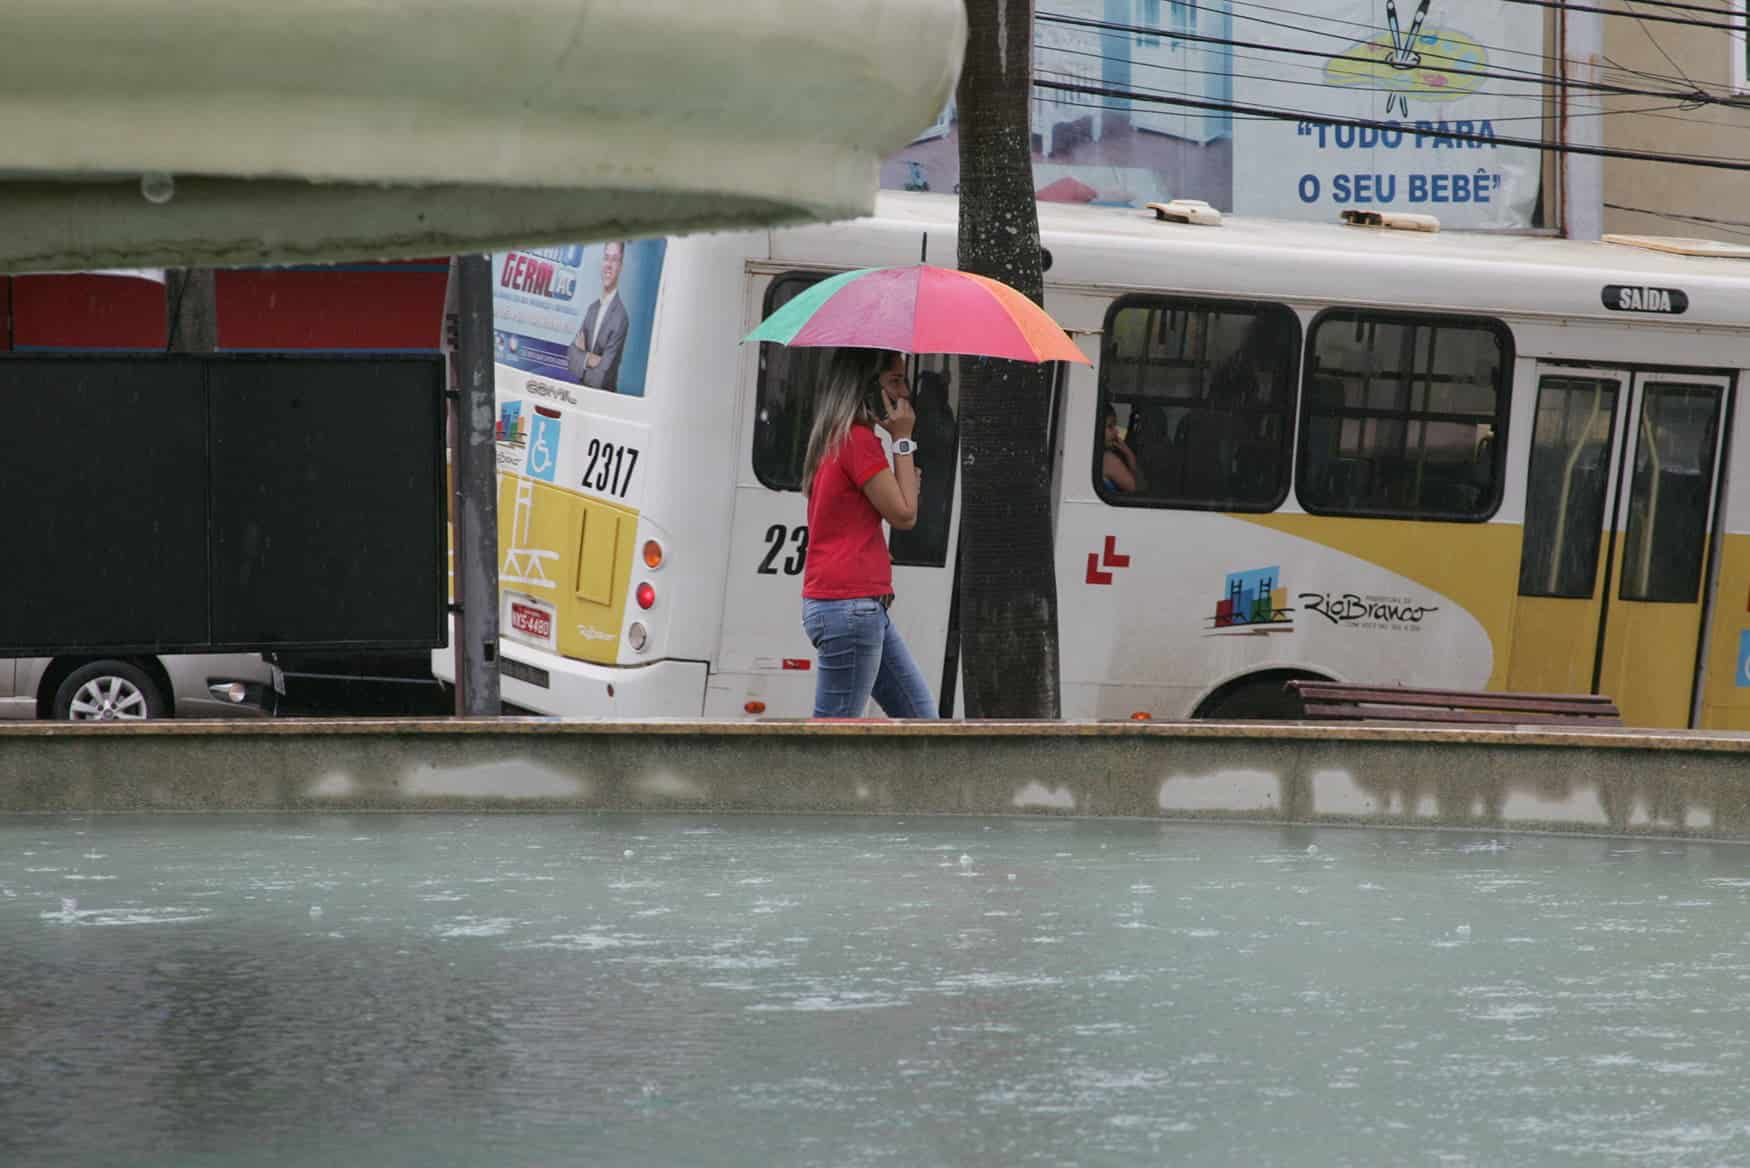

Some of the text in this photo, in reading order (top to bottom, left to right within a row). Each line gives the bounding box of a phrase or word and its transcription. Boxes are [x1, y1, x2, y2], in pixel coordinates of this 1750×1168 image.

[1415, 119, 1497, 149] PARA
[1298, 174, 1320, 203] O
[1332, 174, 1397, 203] SEU
[581, 438, 639, 498] 2317
